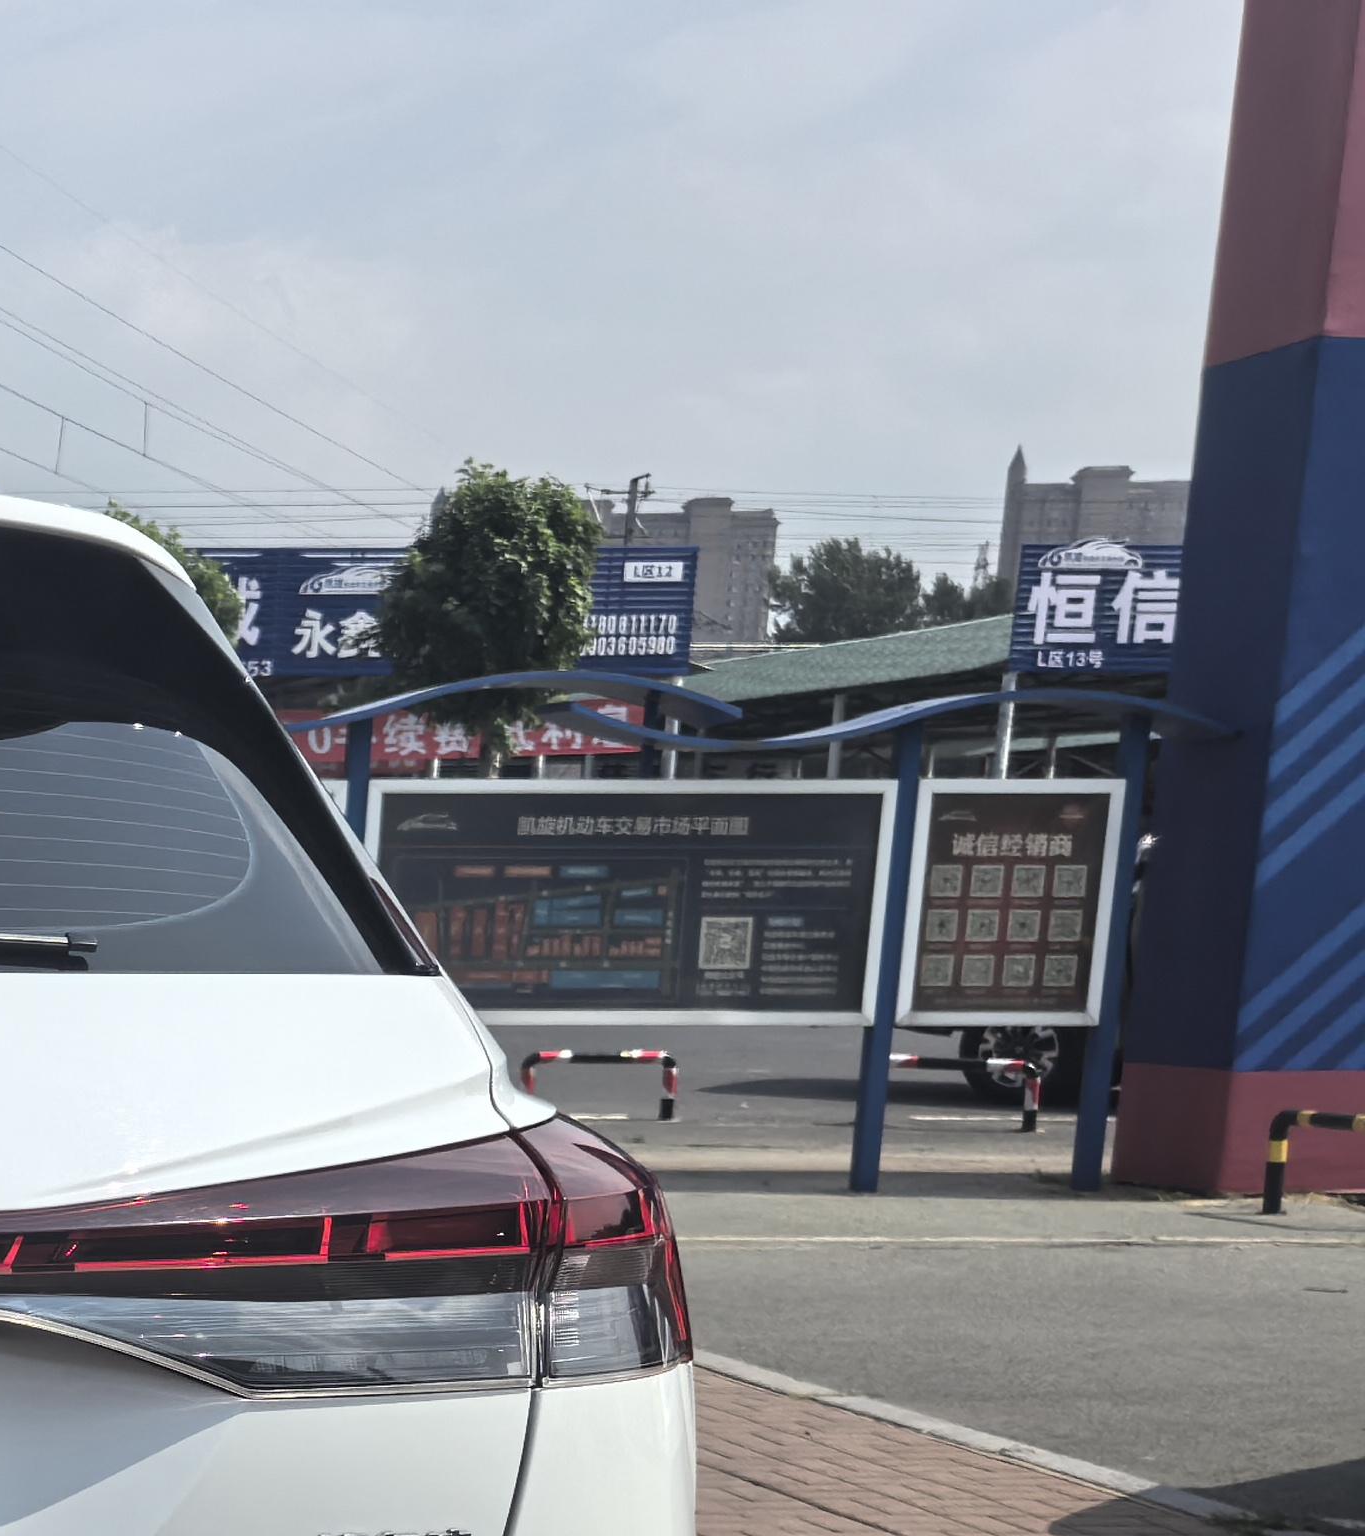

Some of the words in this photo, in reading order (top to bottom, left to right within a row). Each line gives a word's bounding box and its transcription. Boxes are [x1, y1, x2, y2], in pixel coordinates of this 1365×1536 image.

[1027, 570, 1180, 645] 恒信
[1037, 650, 1104, 668] L区13号
[517, 815, 749, 836] 凯旋机动车交易市场平面图
[952, 832, 1073, 857] 诚信经销商
